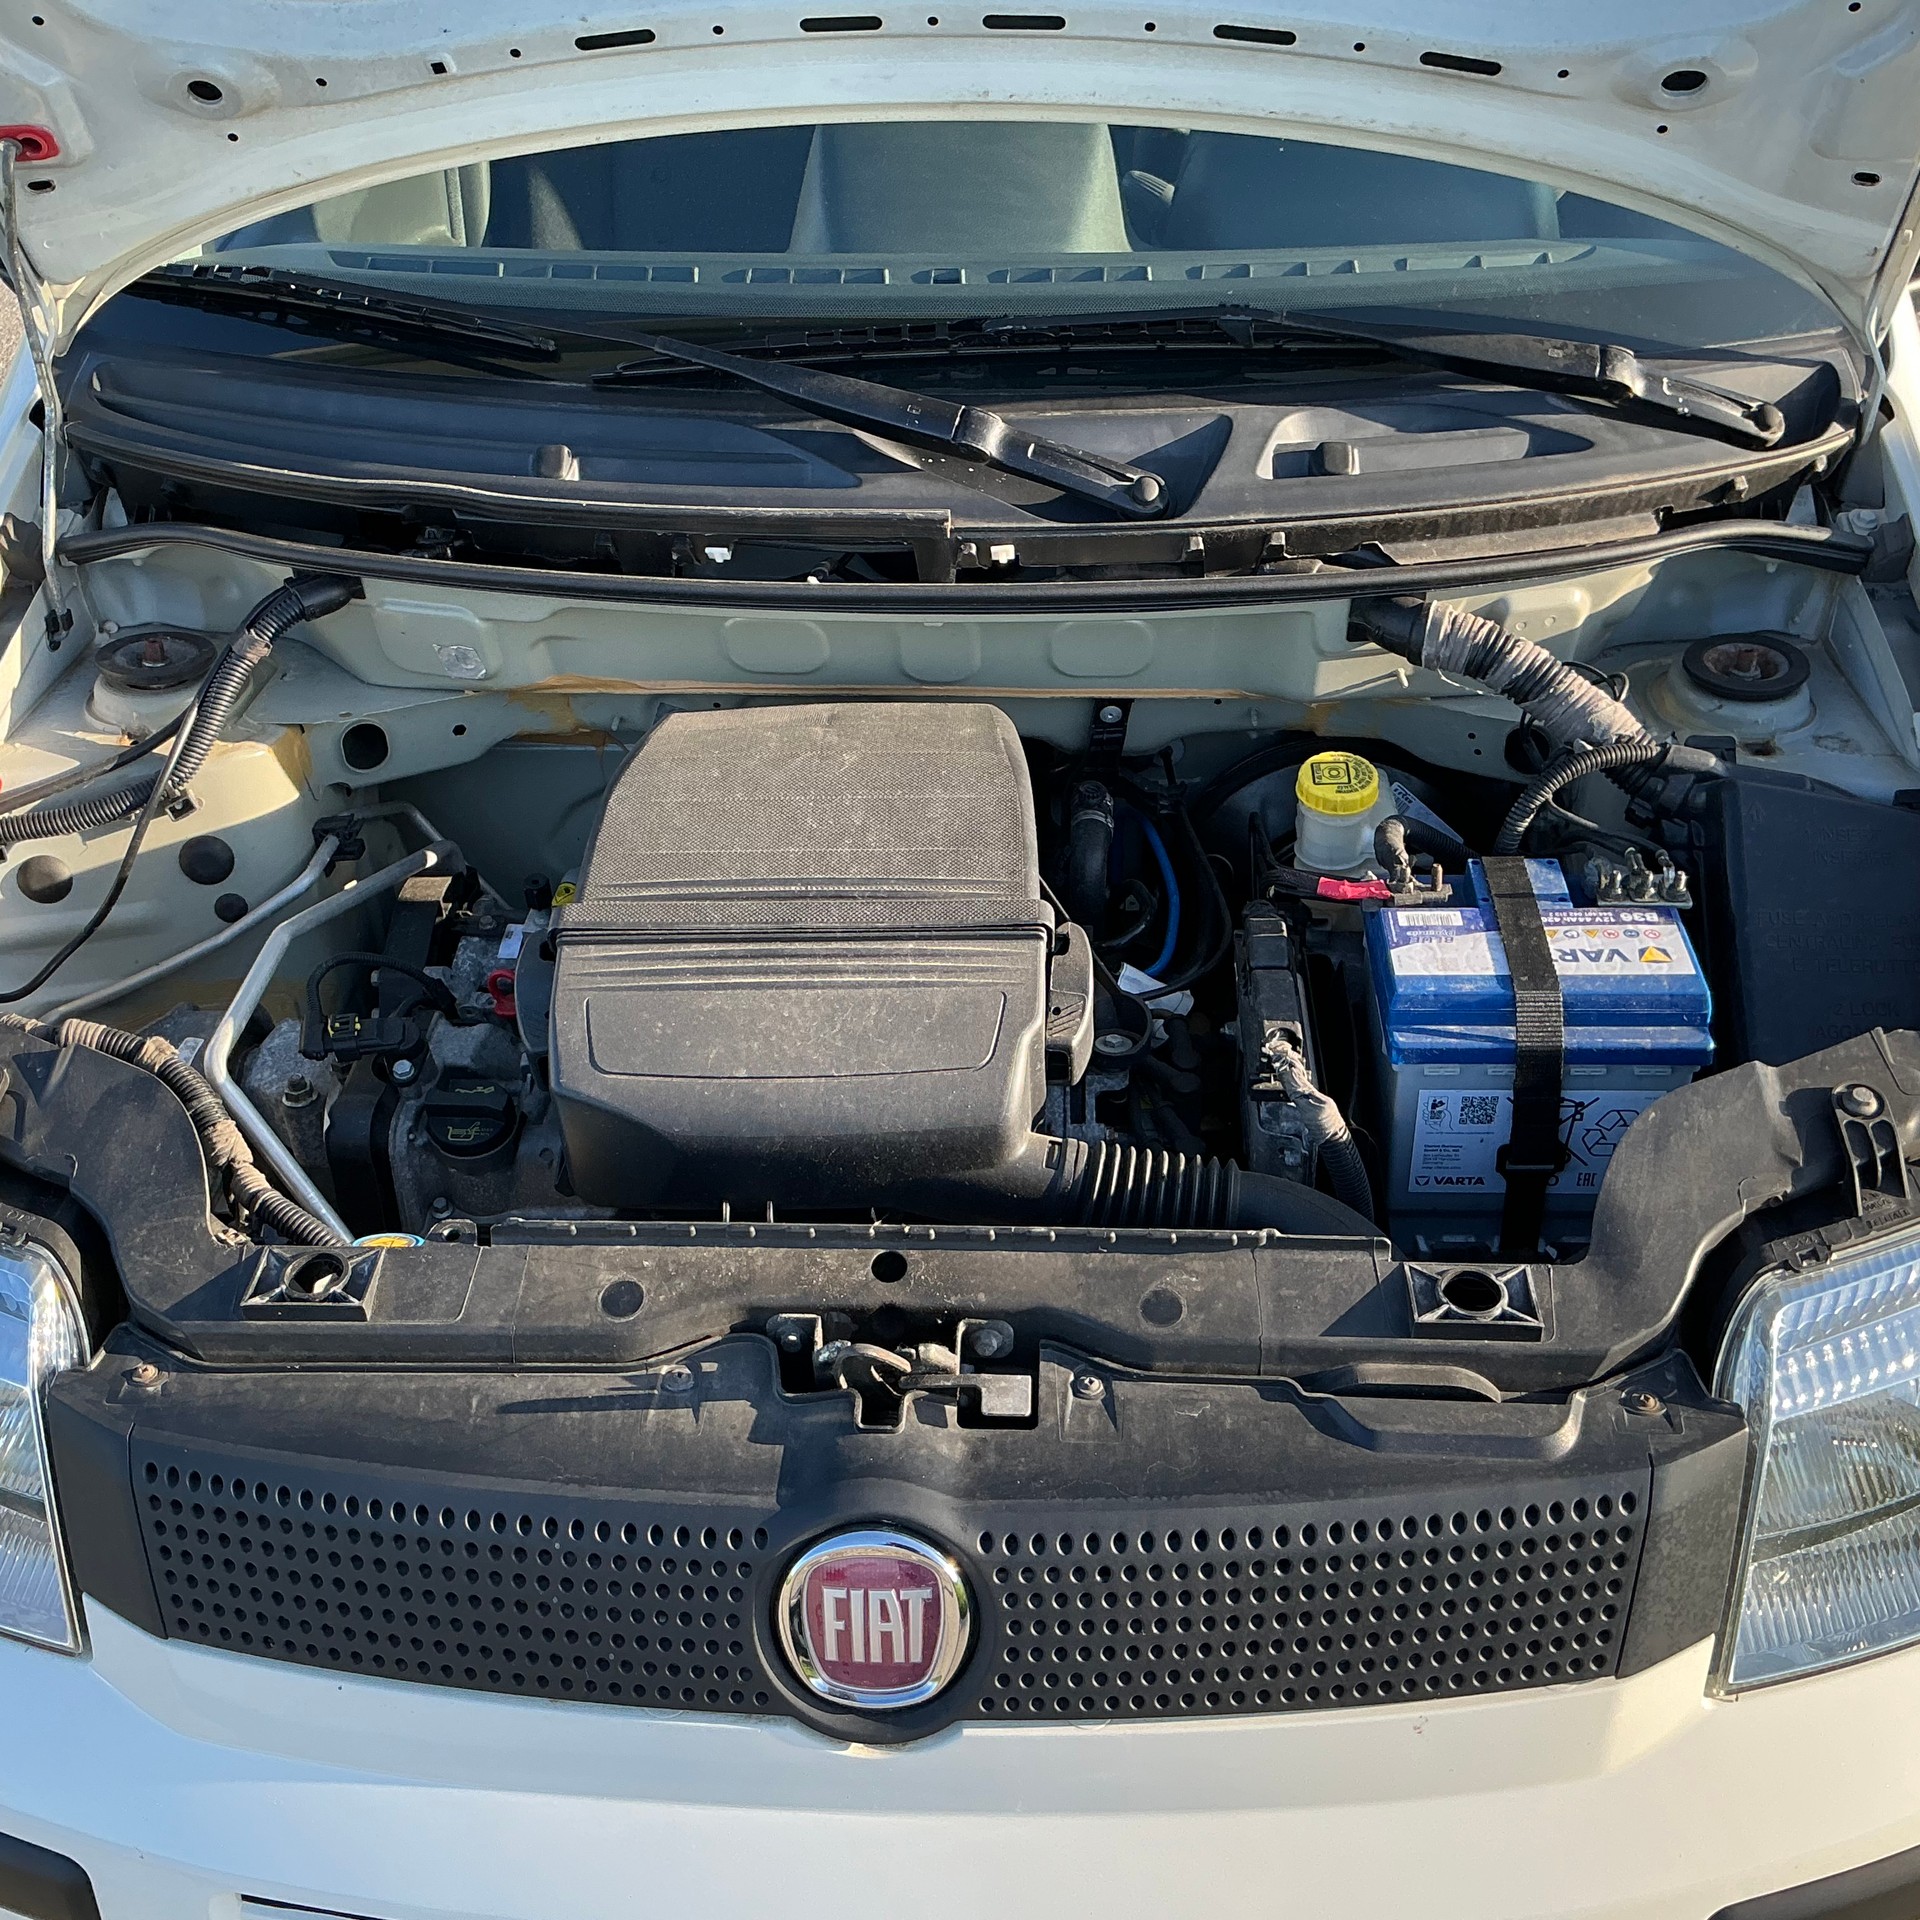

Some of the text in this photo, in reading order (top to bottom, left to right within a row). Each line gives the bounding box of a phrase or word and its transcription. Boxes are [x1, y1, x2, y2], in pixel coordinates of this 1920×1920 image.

[1620, 912, 1659, 922] B36
[1757, 909, 1808, 927] FUSE
[1553, 948, 1632, 962] VAR
[1849, 1001, 1900, 1018] LOCK
[1433, 1176, 1485, 1186] VARTA
[822, 1586, 933, 1664] FIAT
